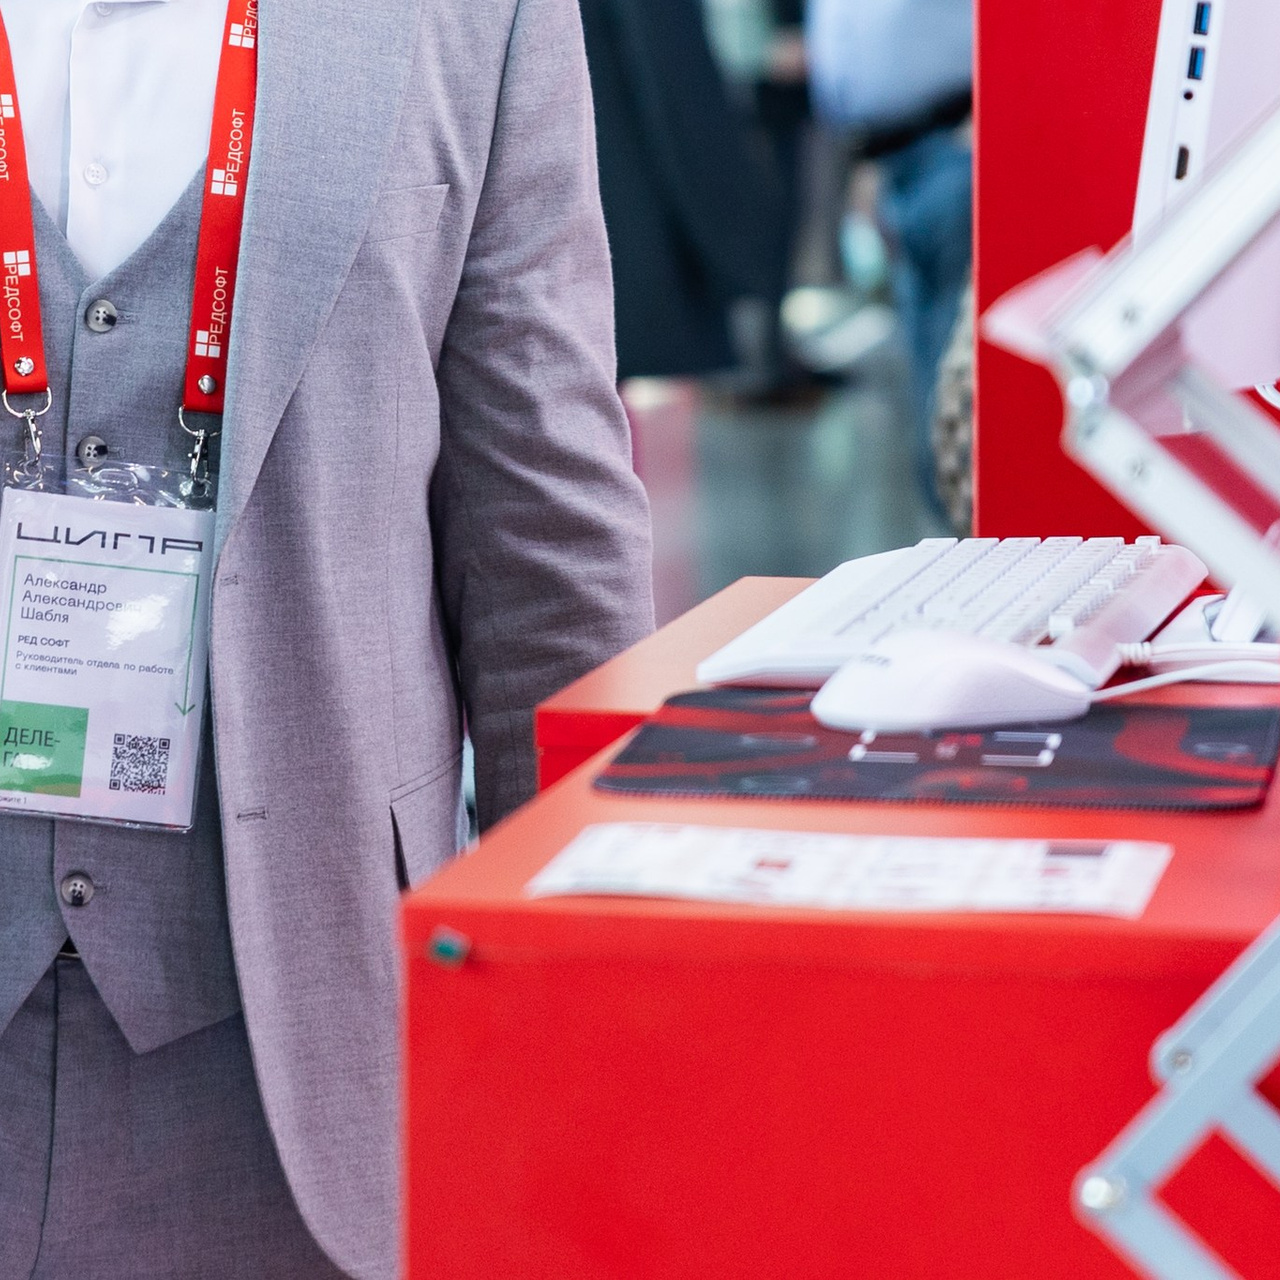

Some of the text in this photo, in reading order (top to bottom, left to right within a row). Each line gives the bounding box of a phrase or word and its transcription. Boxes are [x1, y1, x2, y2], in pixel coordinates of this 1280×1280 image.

[224, 108, 245, 184] РЕДСОФТ
[3, 266, 23, 342] РЕДСОФТ
[209, 266, 228, 345] РЕДСОФТ
[23, 573, 107, 595] Александр
[20, 606, 69, 623] Шабля
[17, 635, 70, 648] РЕД СОФТ
[16, 650, 174, 675] Руководитель отдела по работе
[24, 663, 77, 676] клиентами
[3, 726, 61, 748] ДЕЛЕ-
